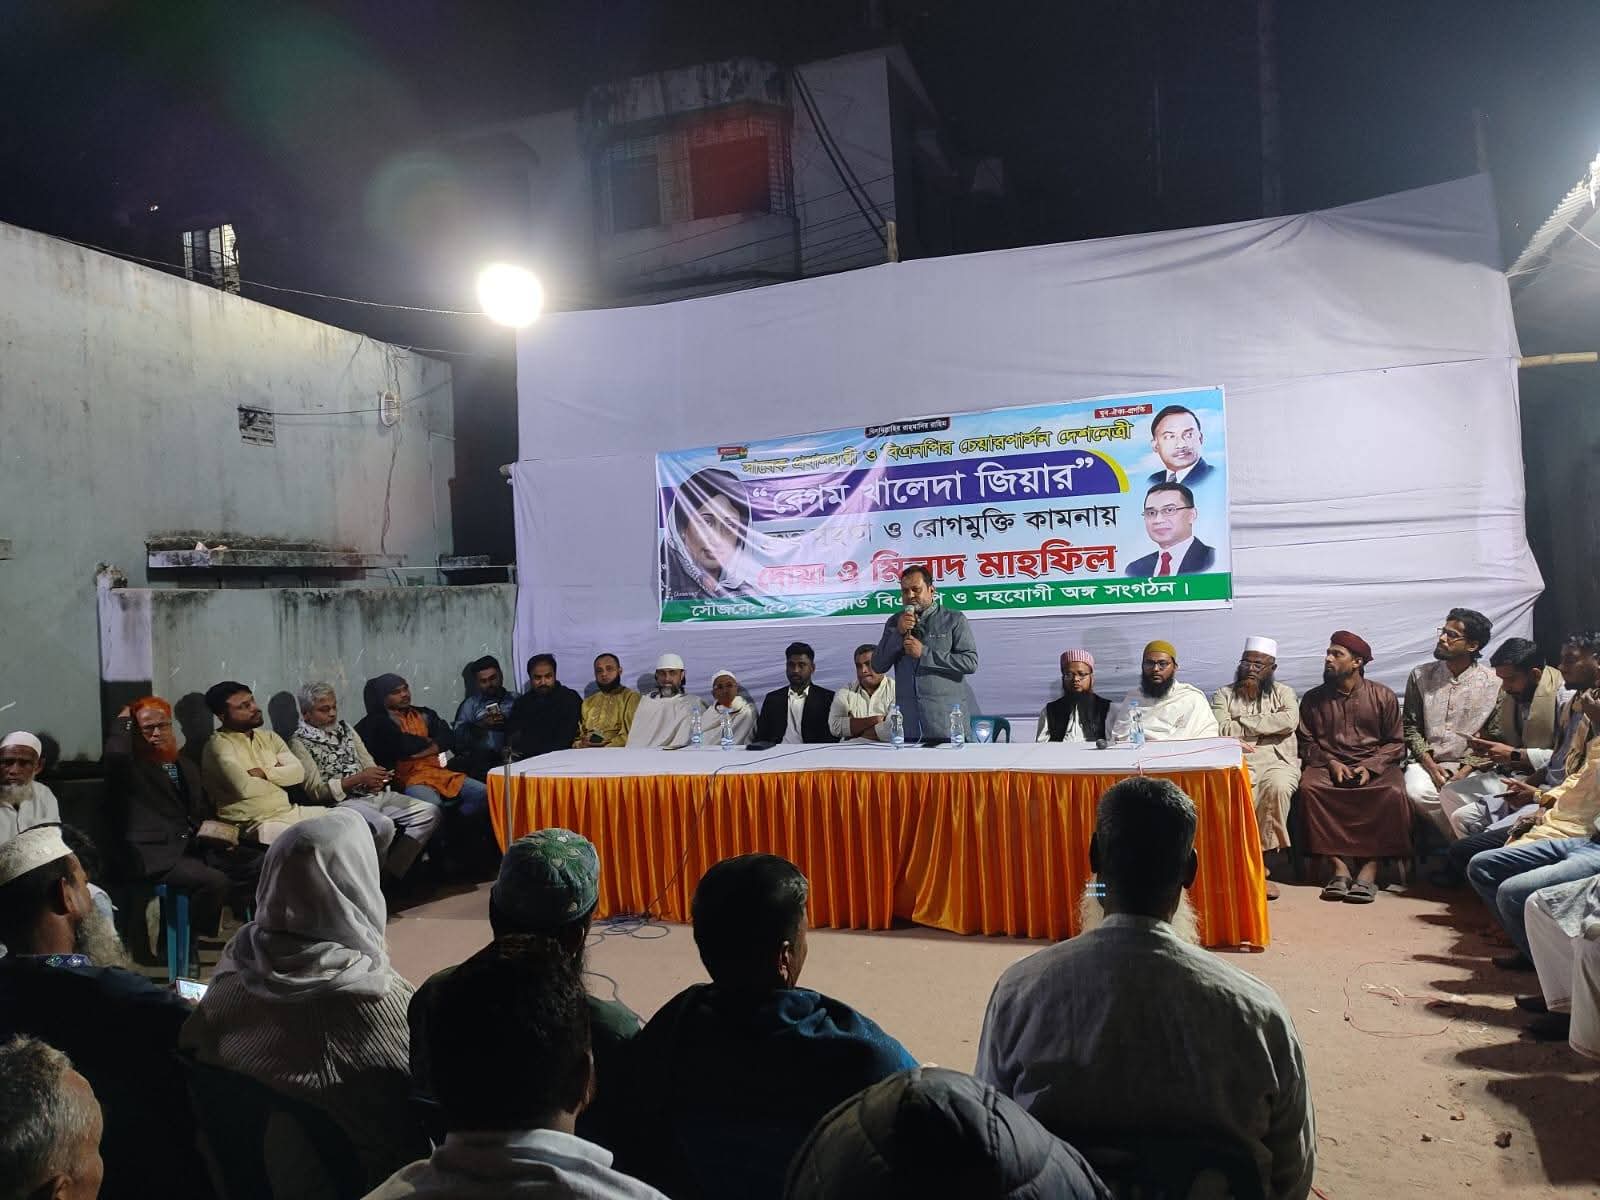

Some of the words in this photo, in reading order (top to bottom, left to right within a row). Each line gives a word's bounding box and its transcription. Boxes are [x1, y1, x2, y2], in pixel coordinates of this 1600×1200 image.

[863, 448, 878, 462] ও
[880, 438, 955, 461] বিএনপির
[959, 426, 1053, 453] চেয়ারপার্সন
[1057, 418, 1135, 444] দেশনেত্রী
[863, 469, 967, 508] খালেদা
[883, 522, 902, 538] ও
[913, 507, 1017, 539] রোগমুক্তি
[1022, 504, 1120, 531] কামনায়
[837, 560, 860, 583] ও
[976, 538, 1118, 578] মাহফিল
[952, 592, 968, 605] ও
[975, 583, 1055, 606] সহযোগী
[1060, 586, 1098, 601] অঙ্গ
[1105, 577, 1178, 599] সংগঠন
